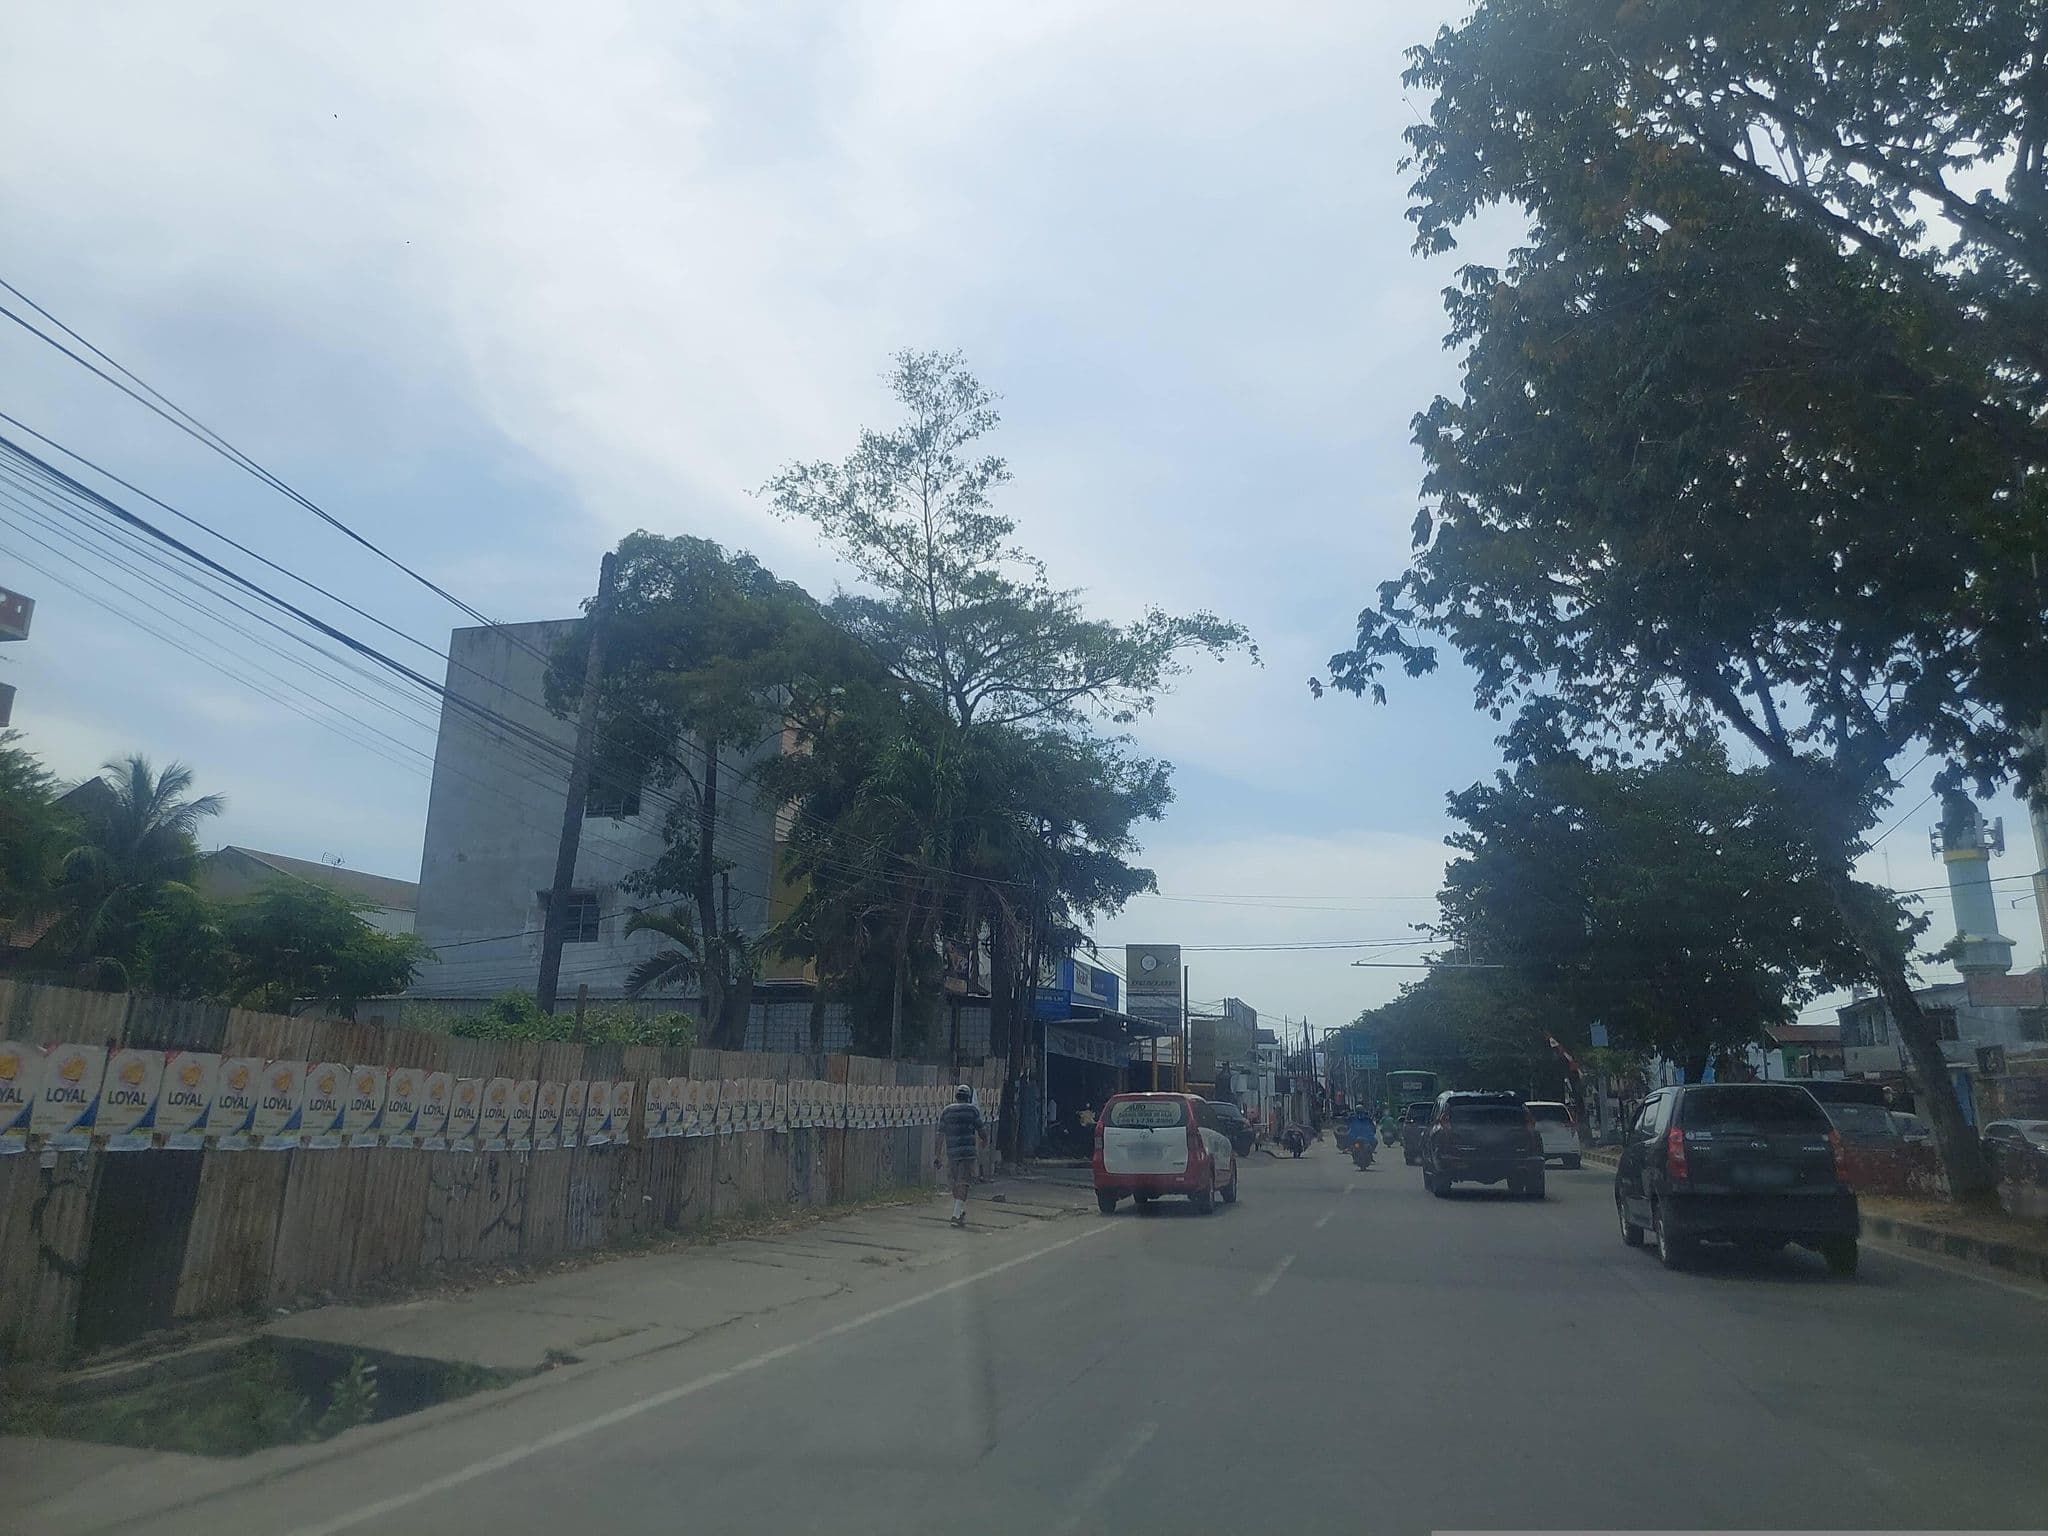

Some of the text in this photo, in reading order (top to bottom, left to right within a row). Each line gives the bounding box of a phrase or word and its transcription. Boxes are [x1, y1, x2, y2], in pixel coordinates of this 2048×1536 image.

[46, 1087, 87, 1103] LOYAL
[108, 1090, 147, 1105] LOYAL
[168, 1092, 204, 1107] LOYAL
[219, 1095, 249, 1109] LOYAL
[263, 1096, 292, 1110] LOYAL
[309, 1099, 337, 1112] LOYAL
[350, 1098, 376, 1111] LOYAL
[388, 1100, 413, 1113] LOYAL
[423, 1104, 446, 1116] LOYAL
[453, 1107, 475, 1119] LOYAL
[484, 1108, 506, 1119] LOYAL
[513, 1108, 531, 1120] LOYAL
[539, 1109, 557, 1120] LOYAL
